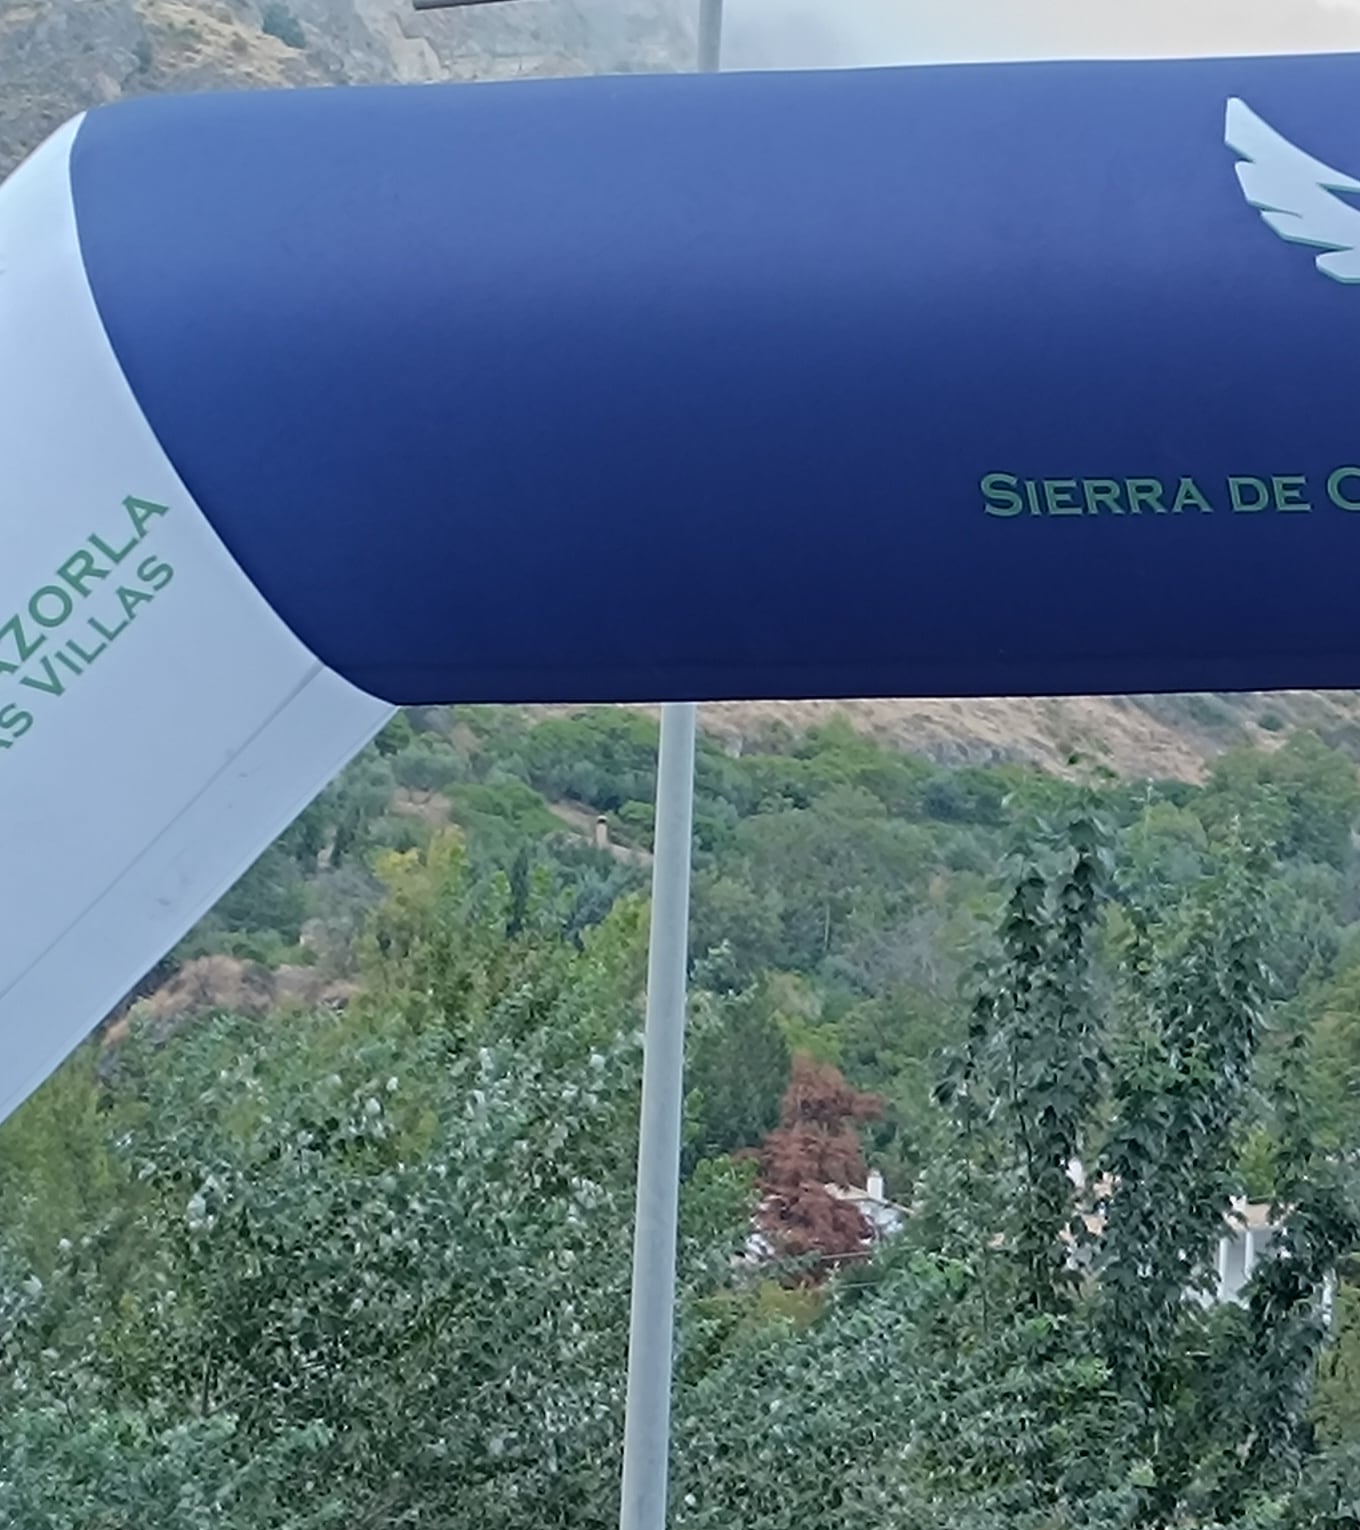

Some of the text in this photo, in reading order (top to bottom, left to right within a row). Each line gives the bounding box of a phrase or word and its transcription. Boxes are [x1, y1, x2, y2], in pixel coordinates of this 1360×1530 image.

[979, 464, 1211, 520] SIERRA
[1229, 470, 1311, 515] DE
[19, 554, 175, 697] VILLAS
